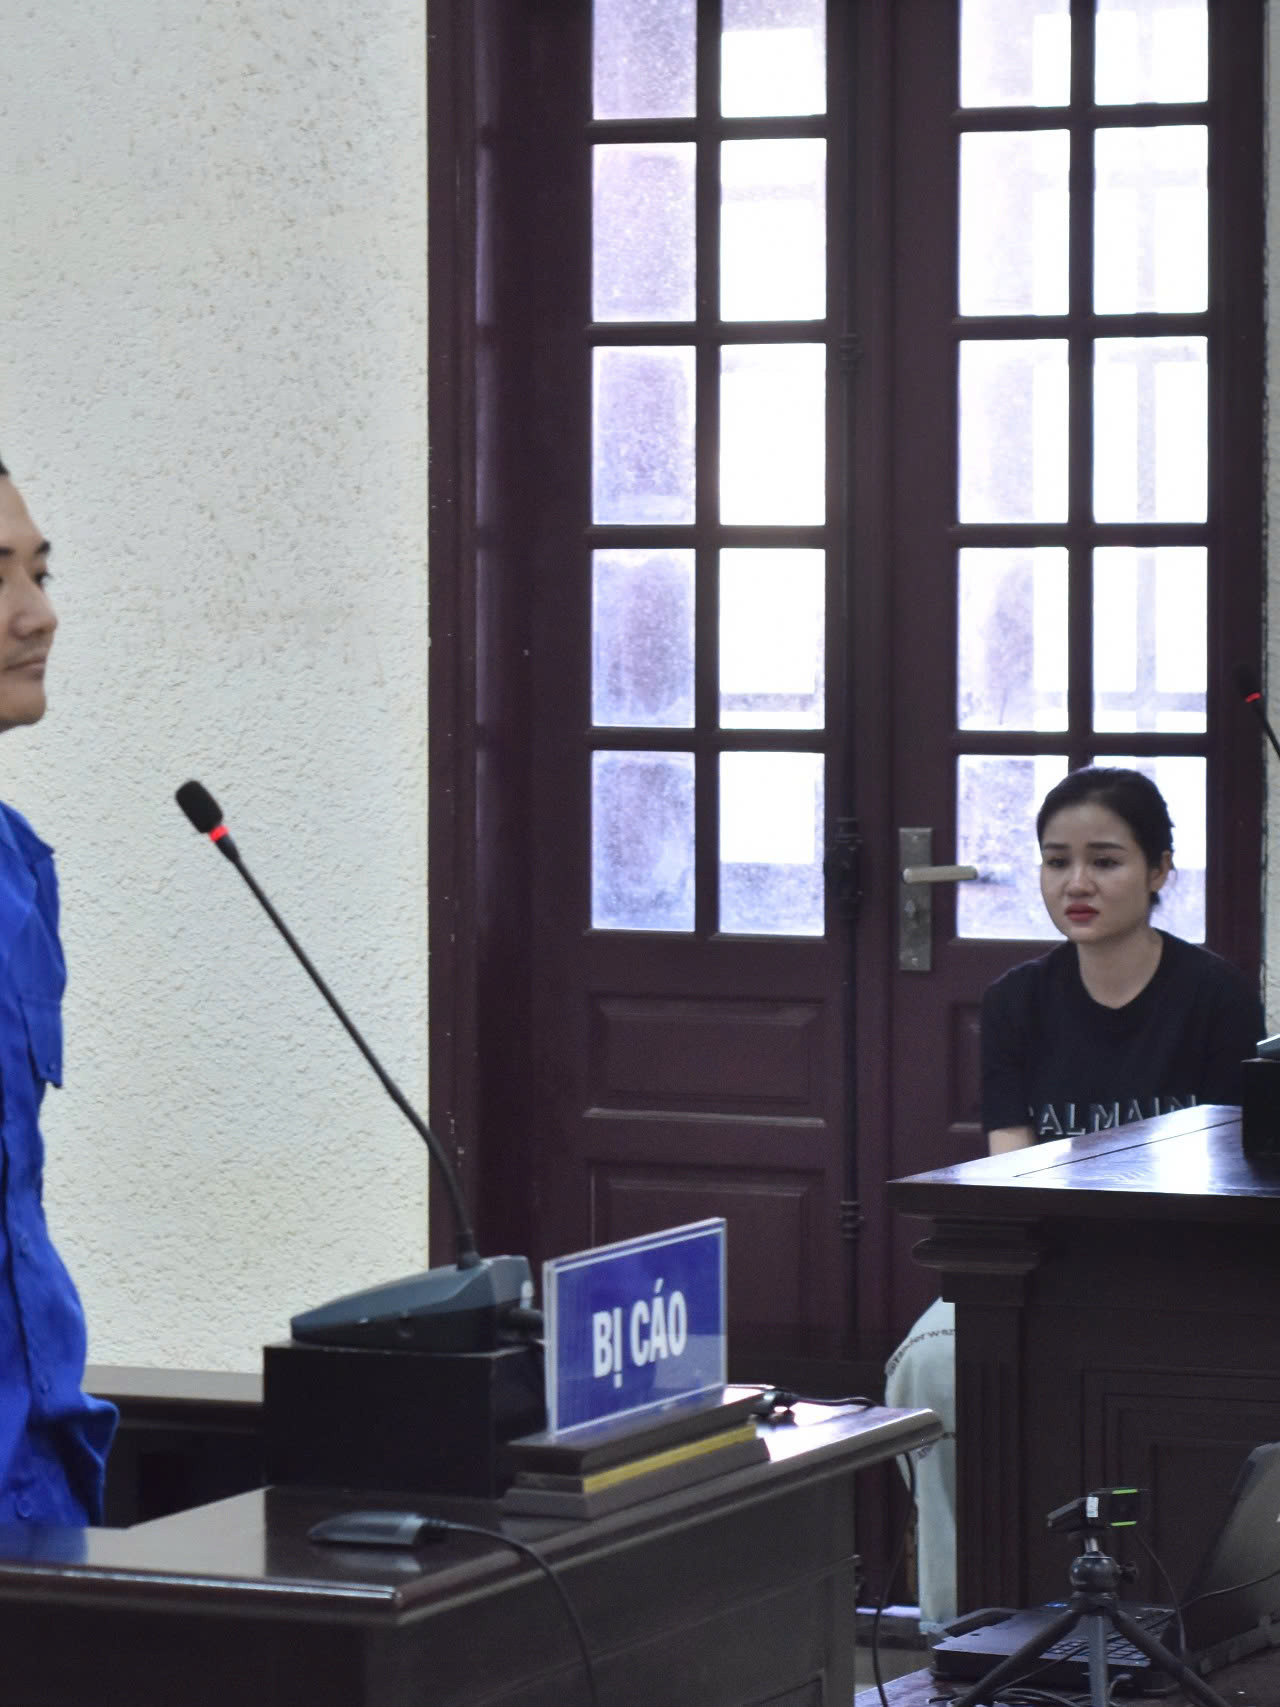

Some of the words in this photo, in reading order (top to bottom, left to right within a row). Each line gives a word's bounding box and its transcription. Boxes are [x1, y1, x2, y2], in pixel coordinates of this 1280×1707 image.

[1028, 1094, 1197, 1136] ALMAI
[593, 1307, 623, 1389] BỊ
[630, 1277, 687, 1367] CÁO
